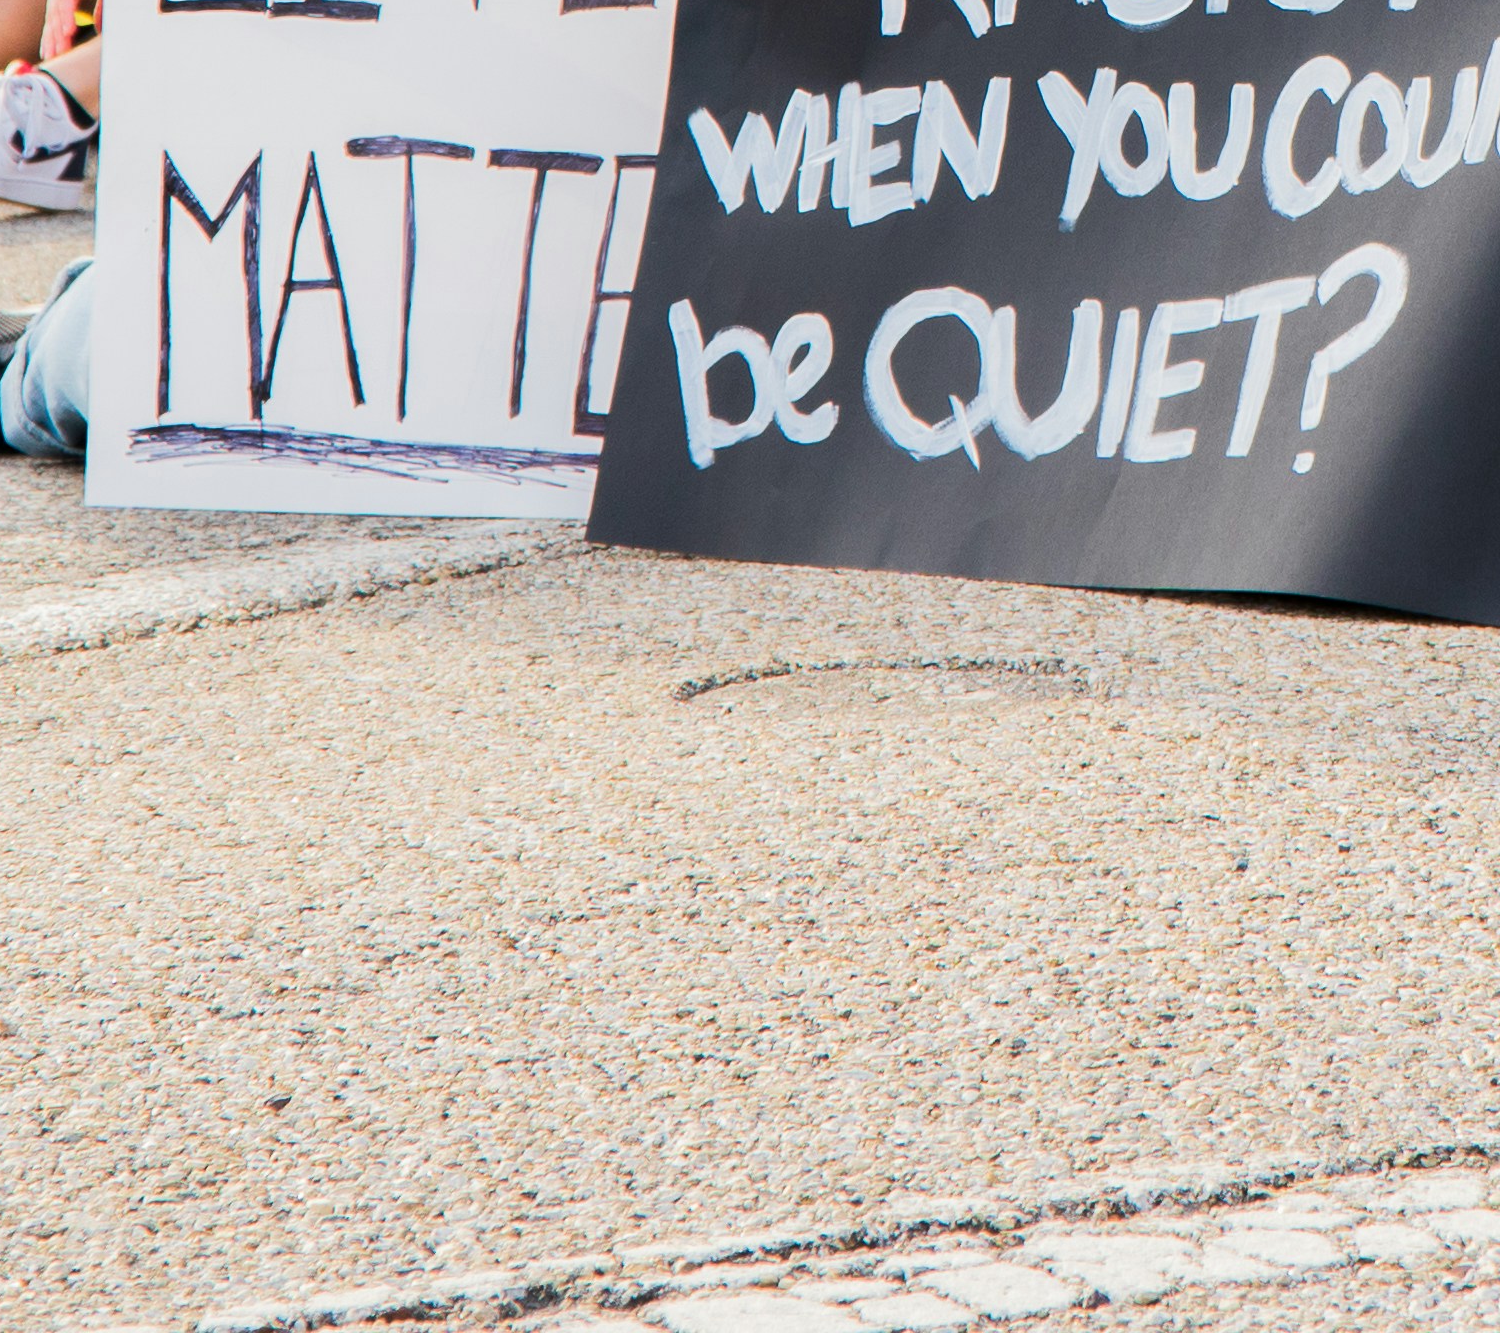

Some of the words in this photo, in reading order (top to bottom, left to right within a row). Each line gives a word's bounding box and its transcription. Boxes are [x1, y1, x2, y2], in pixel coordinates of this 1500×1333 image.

[689, 75, 1012, 228] WHEN
[1037, 66, 1255, 232] YOU
[158, 135, 659, 437] MATTE
[667, 298, 840, 471] be
[862, 242, 1410, 474] QUIET?
